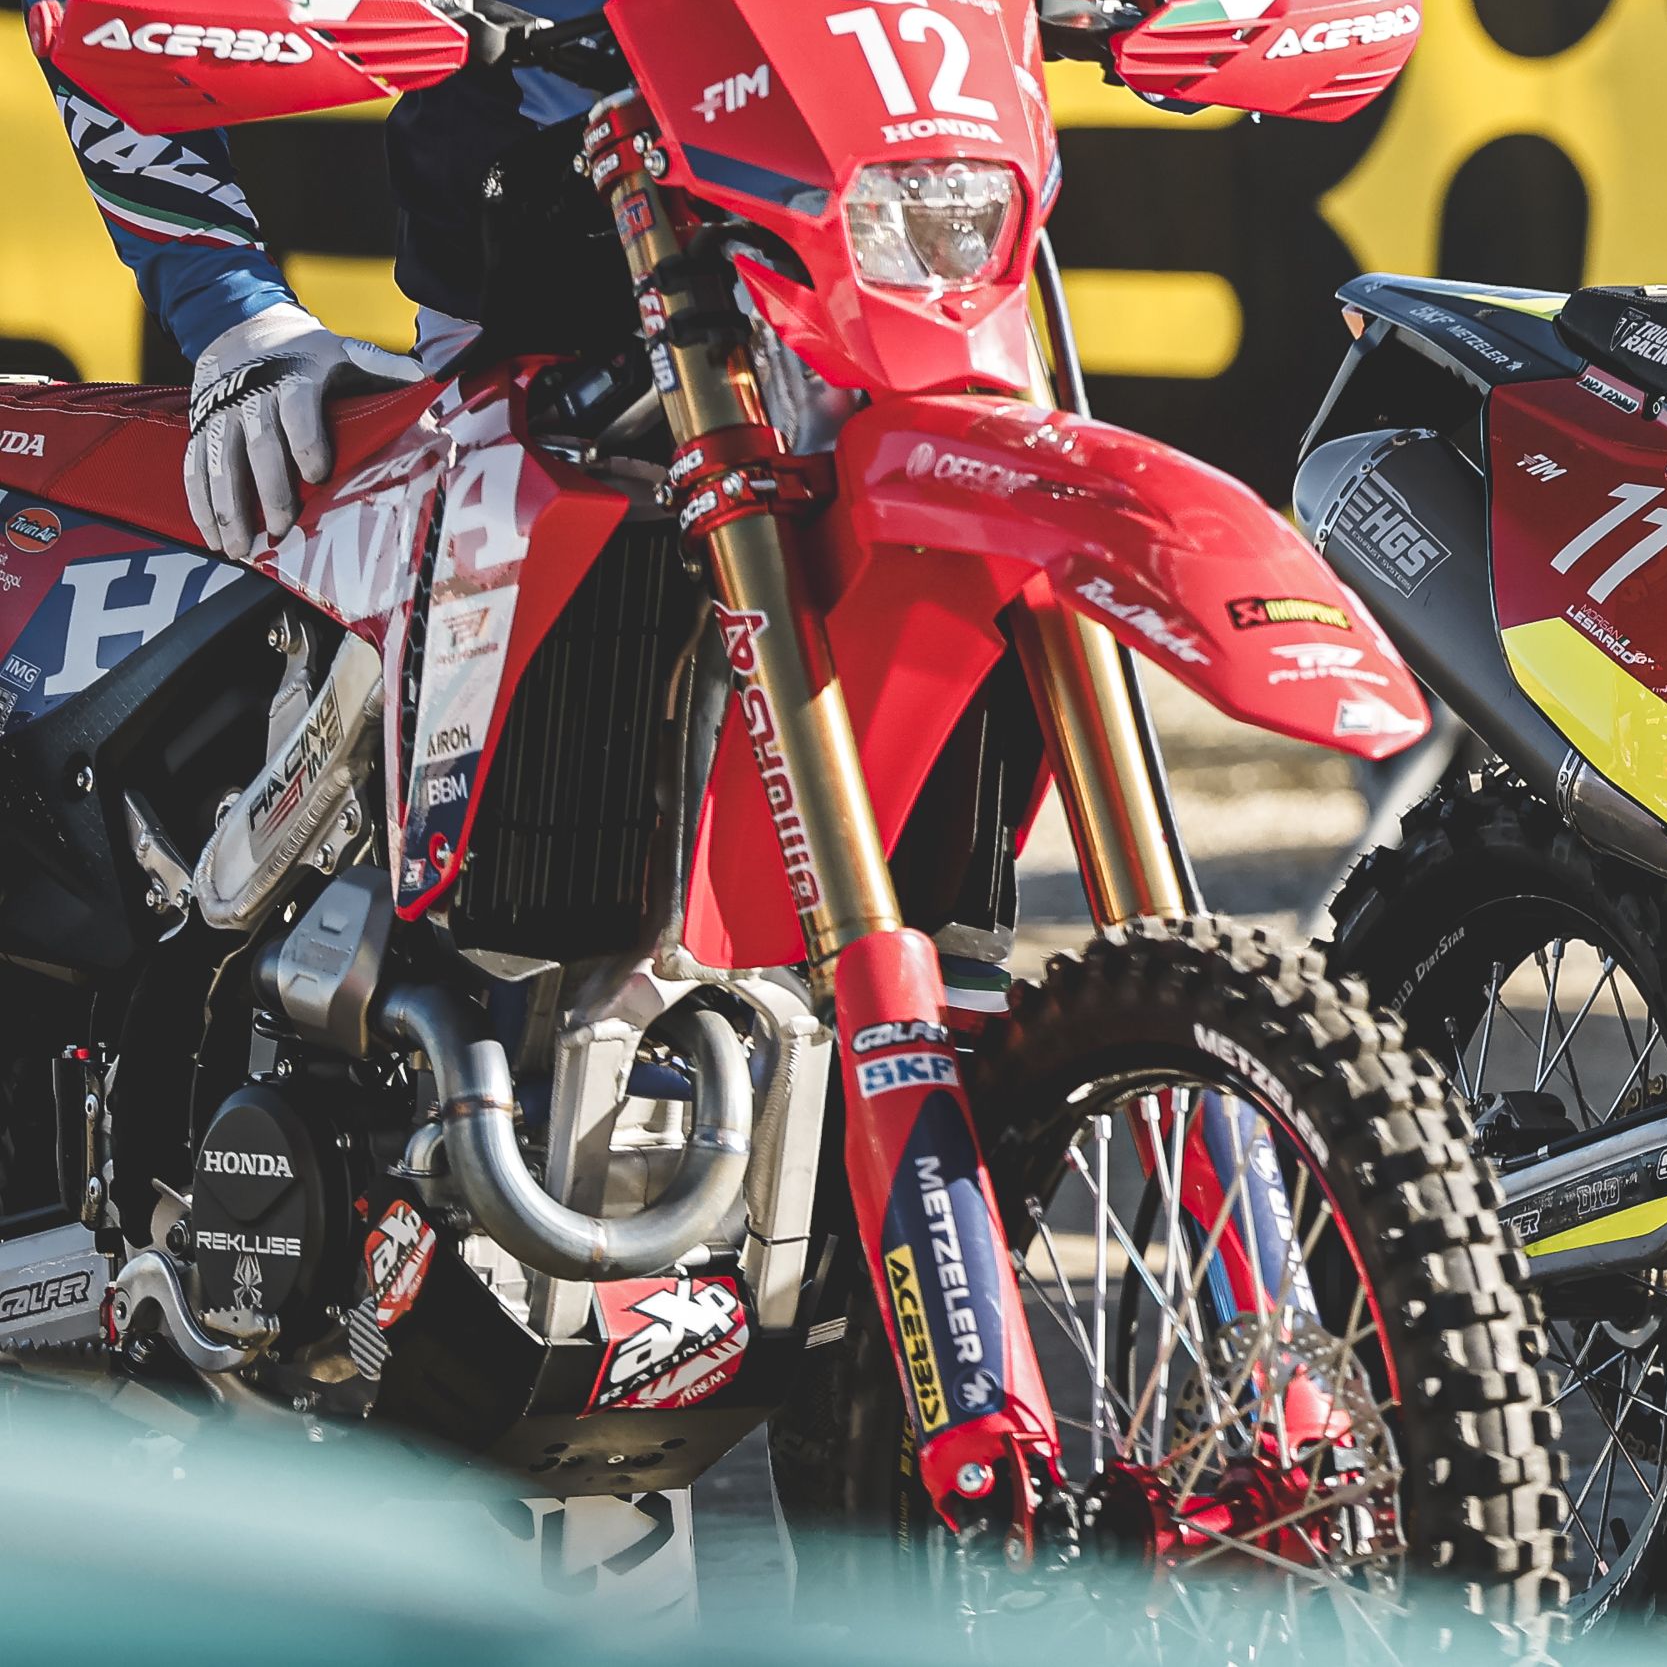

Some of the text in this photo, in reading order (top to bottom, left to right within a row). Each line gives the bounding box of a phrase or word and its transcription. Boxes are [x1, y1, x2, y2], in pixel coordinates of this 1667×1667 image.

[82, 18, 315, 64] ACERBIS
[1265, 4, 1421, 60] ACERBIS
[826, 6, 999, 122] 12
[701, 64, 770, 124] FIM
[880, 119, 1004, 144] HONDA
[1447, 322, 1511, 366] METZELER
[1360, 502, 1440, 578] HGS
[5, 655, 39, 686] IMG
[426, 722, 472, 760] AIROH
[427, 771, 469, 807] BBM
[863, 1055, 954, 1091] SKF
[204, 1150, 293, 1180] HONDA
[196, 1231, 301, 1258] REKLUSE
[914, 1154, 985, 1366] METZELER
[888, 1255, 942, 1429] ACERBIS
